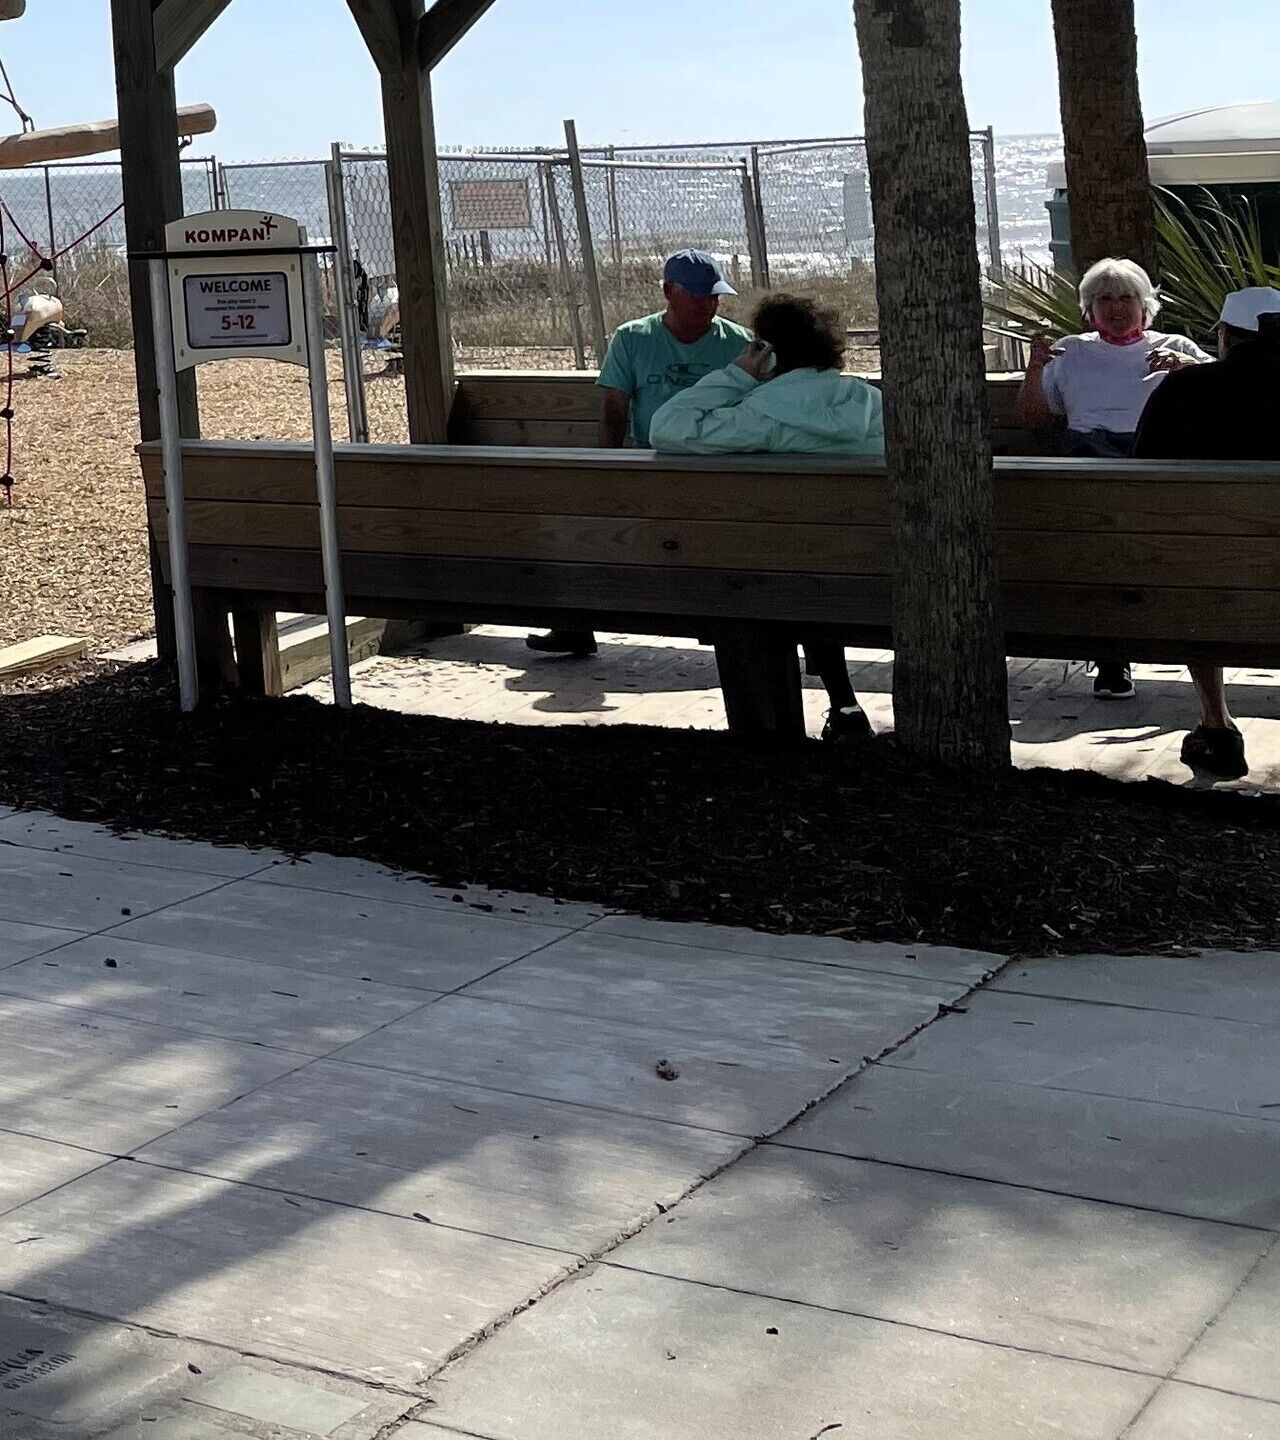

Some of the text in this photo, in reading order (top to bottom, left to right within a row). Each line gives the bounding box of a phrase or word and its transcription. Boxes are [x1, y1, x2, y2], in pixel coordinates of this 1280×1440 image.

[184, 227, 265, 244] KOMPAN
[199, 279, 272, 294] WELCOME
[221, 313, 256, 331] 5-12
